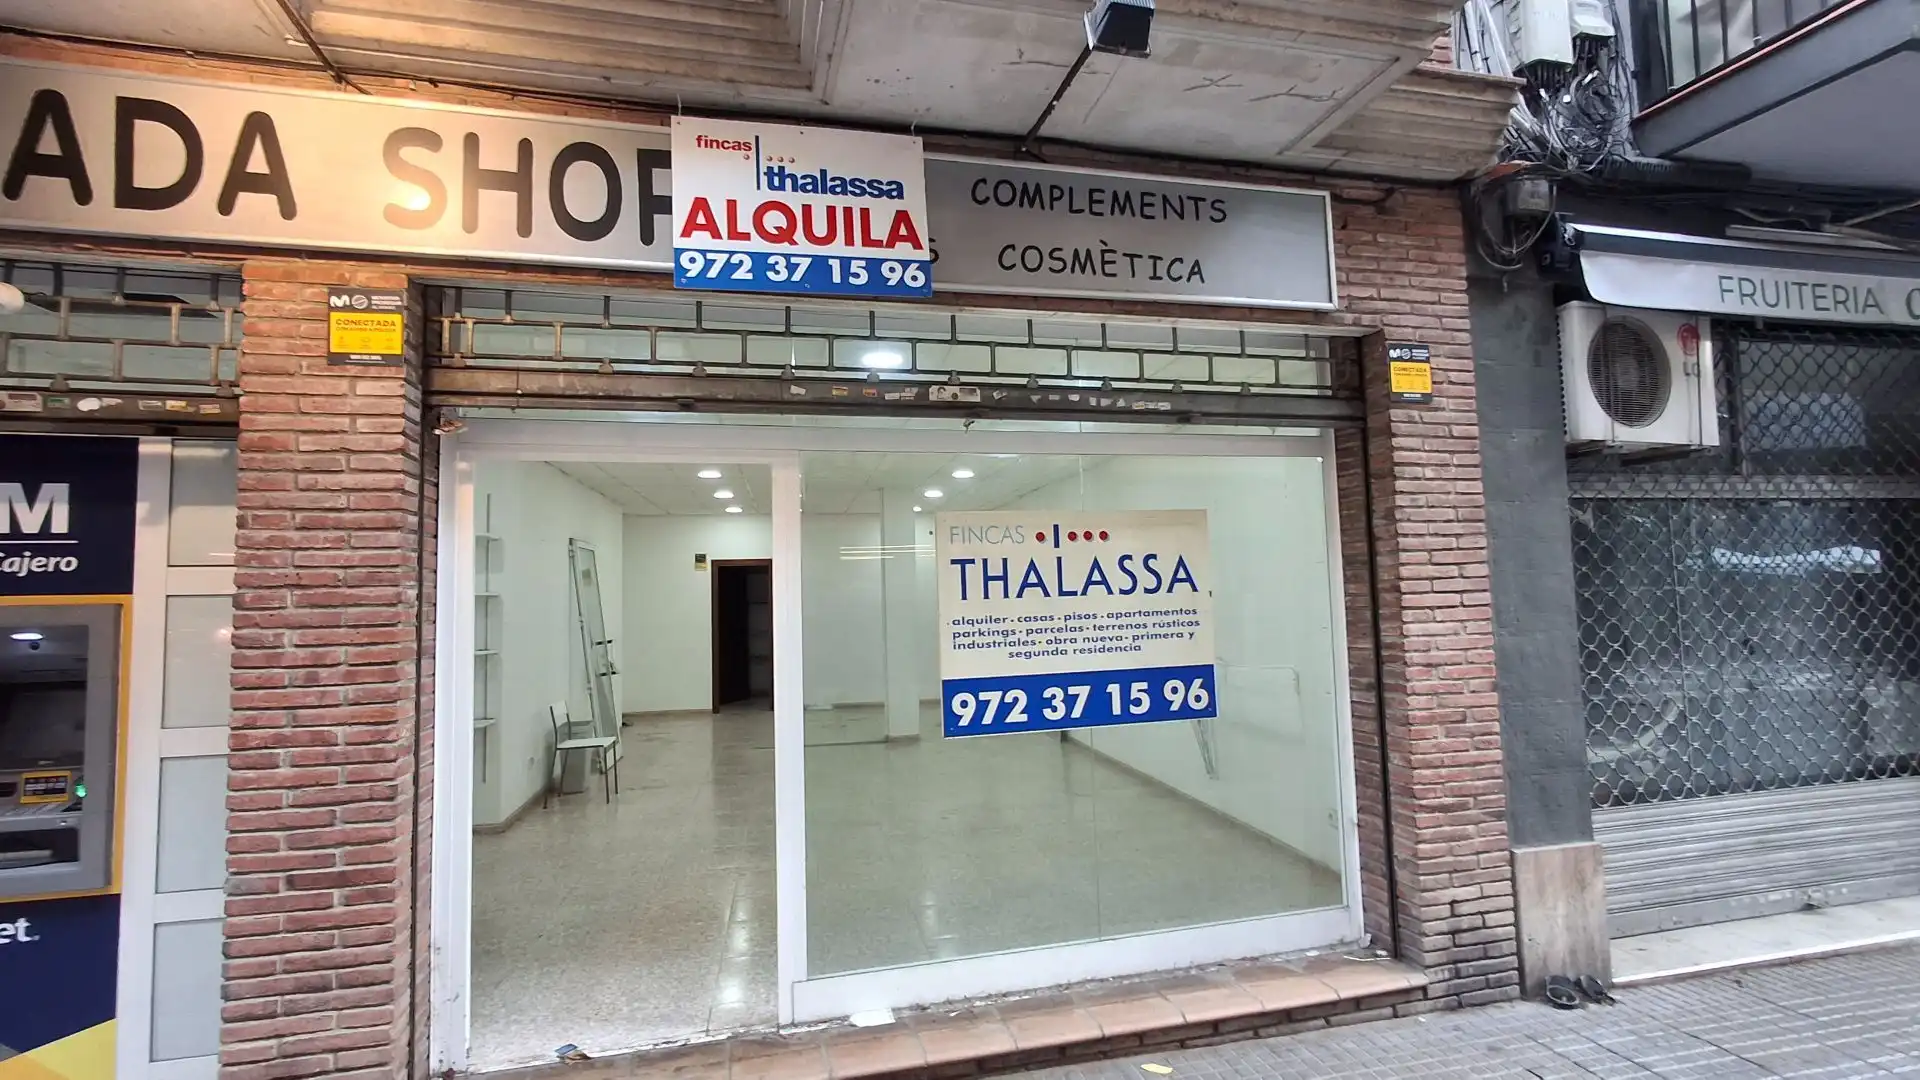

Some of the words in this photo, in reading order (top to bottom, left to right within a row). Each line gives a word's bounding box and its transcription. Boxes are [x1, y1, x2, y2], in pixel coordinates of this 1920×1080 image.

[3, 89, 297, 221] ADA
[696, 135, 752, 152] fincas
[764, 165, 904, 200] thalassa
[971, 178, 1227, 223] COMPLEMENTS
[680, 196, 924, 250] ALQUILA
[680, 251, 753, 279] 972
[766, 255, 812, 282] 37
[828, 259, 868, 285] 15
[881, 261, 926, 287] 96
[998, 240, 1205, 284] COSMÈTICA
[1718, 275, 1884, 316] FRUITERIA
[949, 526, 1025, 545] FINCAS
[0, 551, 79, 577] ajero
[950, 554, 1198, 600] THALASSA
[952, 615, 1008, 627] alquiler
[1017, 614, 1054, 623] casas
[1064, 612, 1098, 623] pisos
[1107, 608, 1197, 620] apartamentos
[952, 628, 1016, 640] parkings
[1026, 624, 1084, 636] parcelas
[1093, 622, 1148, 632] terrenos
[1152, 619, 1200, 629] rústicos
[952, 638, 1036, 650] industriales
[1045, 636, 1077, 645] obra
[1082, 635, 1123, 643] nueva
[1132, 632, 1184, 642] primera
[1188, 631, 1195, 640] y
[1008, 647, 1068, 659] segunda
[1073, 644, 1142, 655] residencia
[951, 688, 1028, 726] 972
[1042, 685, 1091, 720] 37
[1105, 681, 1150, 716] 15
[1163, 678, 1209, 711] 96
